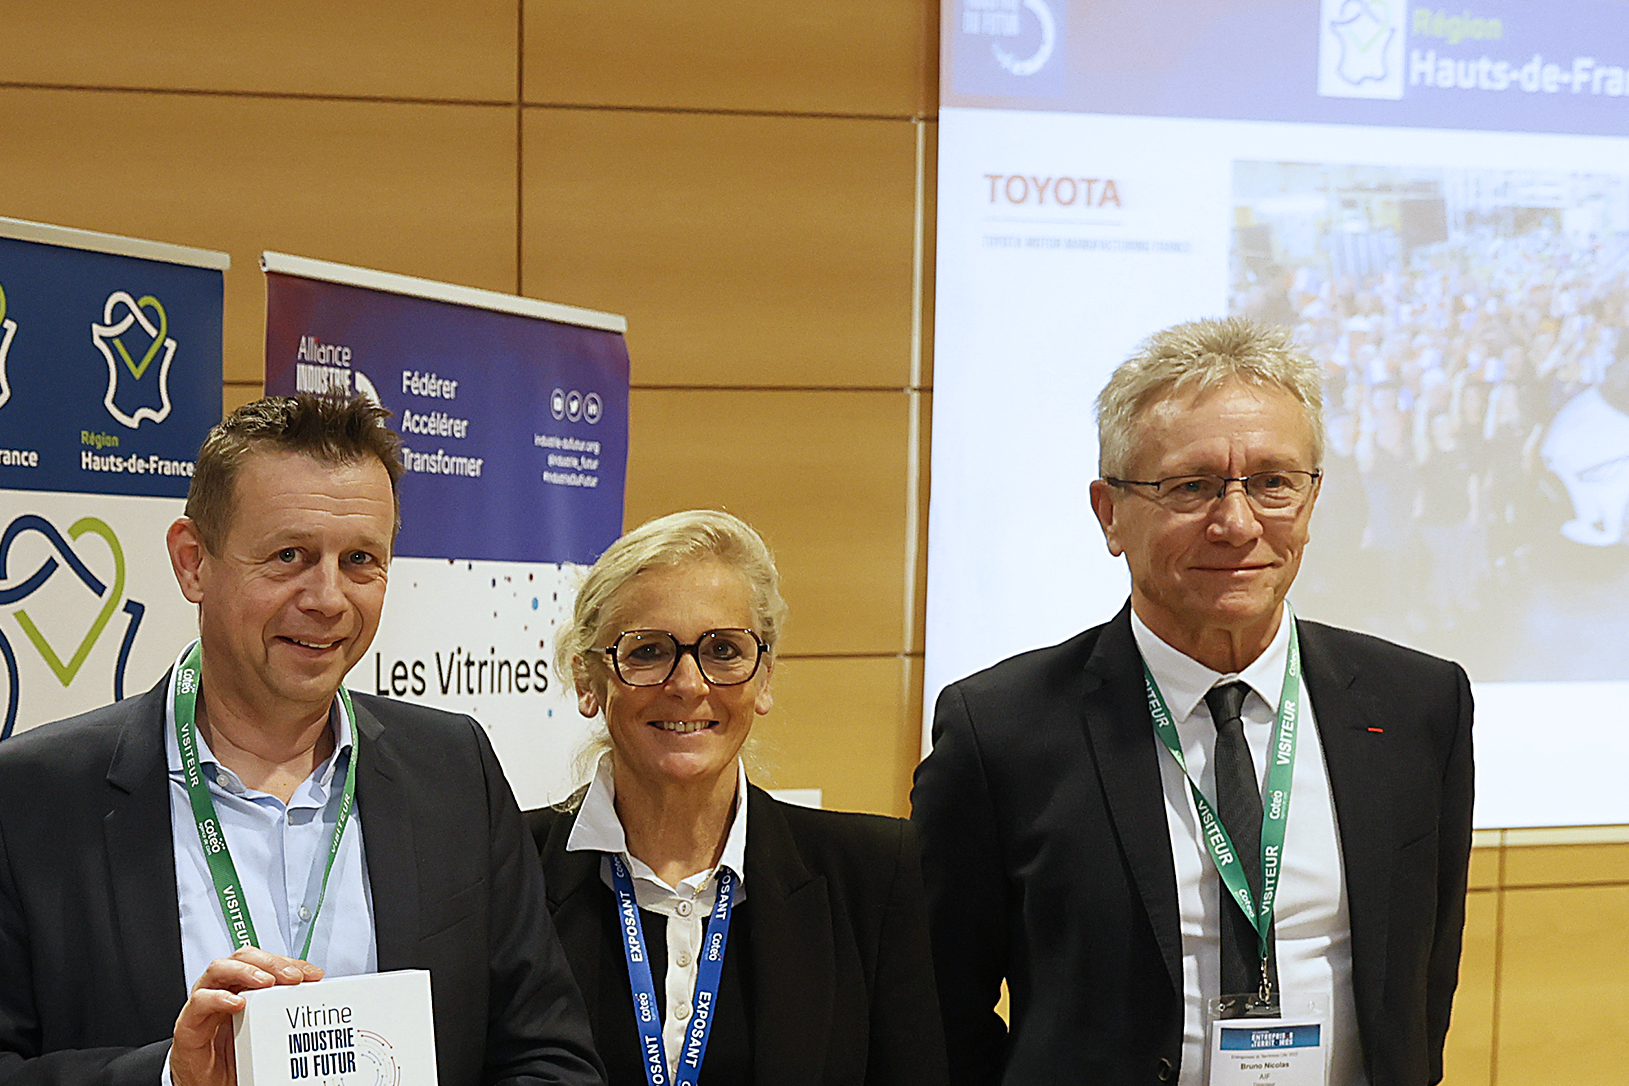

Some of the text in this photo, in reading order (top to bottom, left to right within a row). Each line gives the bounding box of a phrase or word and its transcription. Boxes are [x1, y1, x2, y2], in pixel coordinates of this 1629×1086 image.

[1409, 49, 1629, 96] Hauts-de-Fra
[984, 174, 1122, 207] TOYOTA
[297, 335, 352, 367] Alliance
[402, 371, 458, 399] Fédérer
[401, 409, 469, 439] Accélérer
[81, 431, 120, 450] Région
[81, 451, 195, 477] Hauts-de-France
[401, 447, 484, 477] Transformer
[376, 652, 426, 697] Les
[435, 646, 548, 695] Vitrines
[1144, 679, 1170, 728] ITEUR
[1276, 700, 1296, 767] VISITEUR
[180, 723, 200, 788] VISITEUR
[1198, 799, 1234, 866] VISITEUR
[1261, 845, 1279, 916] VISITEUR
[620, 890, 644, 962] EXPOSANT
[286, 1003, 352, 1029] Vitrine
[685, 991, 712, 1068] EXPOSANT
[288, 1027, 355, 1054] INDUSTRIE
[290, 1051, 356, 1080] DU FUTUR
[1240, 1061, 1290, 1071] Bruno Nicolas
